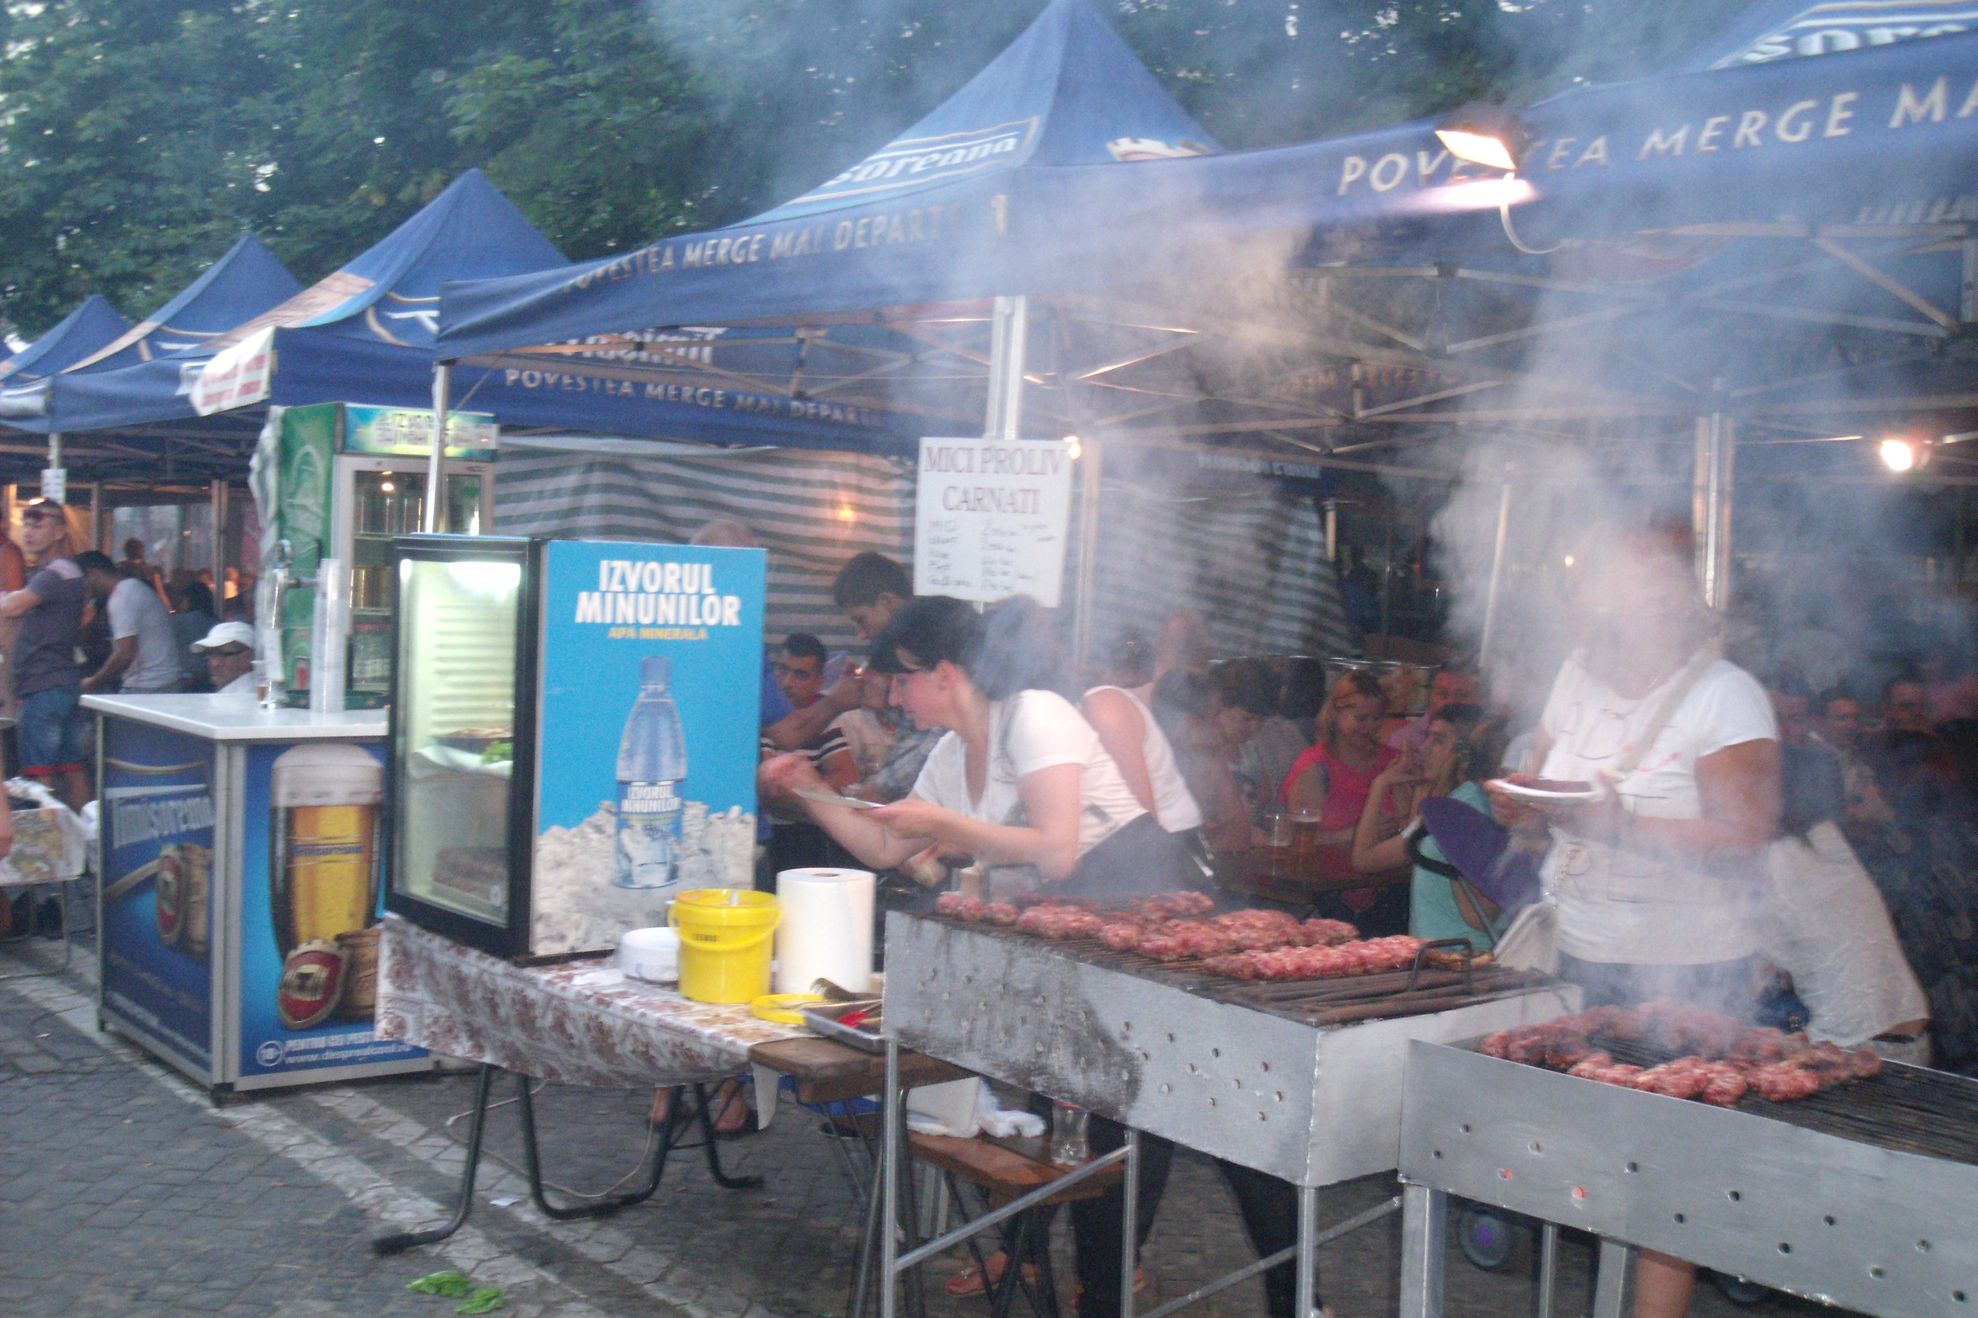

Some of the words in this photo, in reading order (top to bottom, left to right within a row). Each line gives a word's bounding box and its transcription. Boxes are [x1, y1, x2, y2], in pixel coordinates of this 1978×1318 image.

[1636, 92, 1860, 161] MERGE
[682, 233, 766, 269] MERGE
[769, 221, 823, 260] MAI
[505, 368, 635, 398] POVESTEA
[644, 382, 726, 410] MERGE
[598, 559, 717, 595] IZVORUL
[574, 591, 742, 626] MINUNILOR
